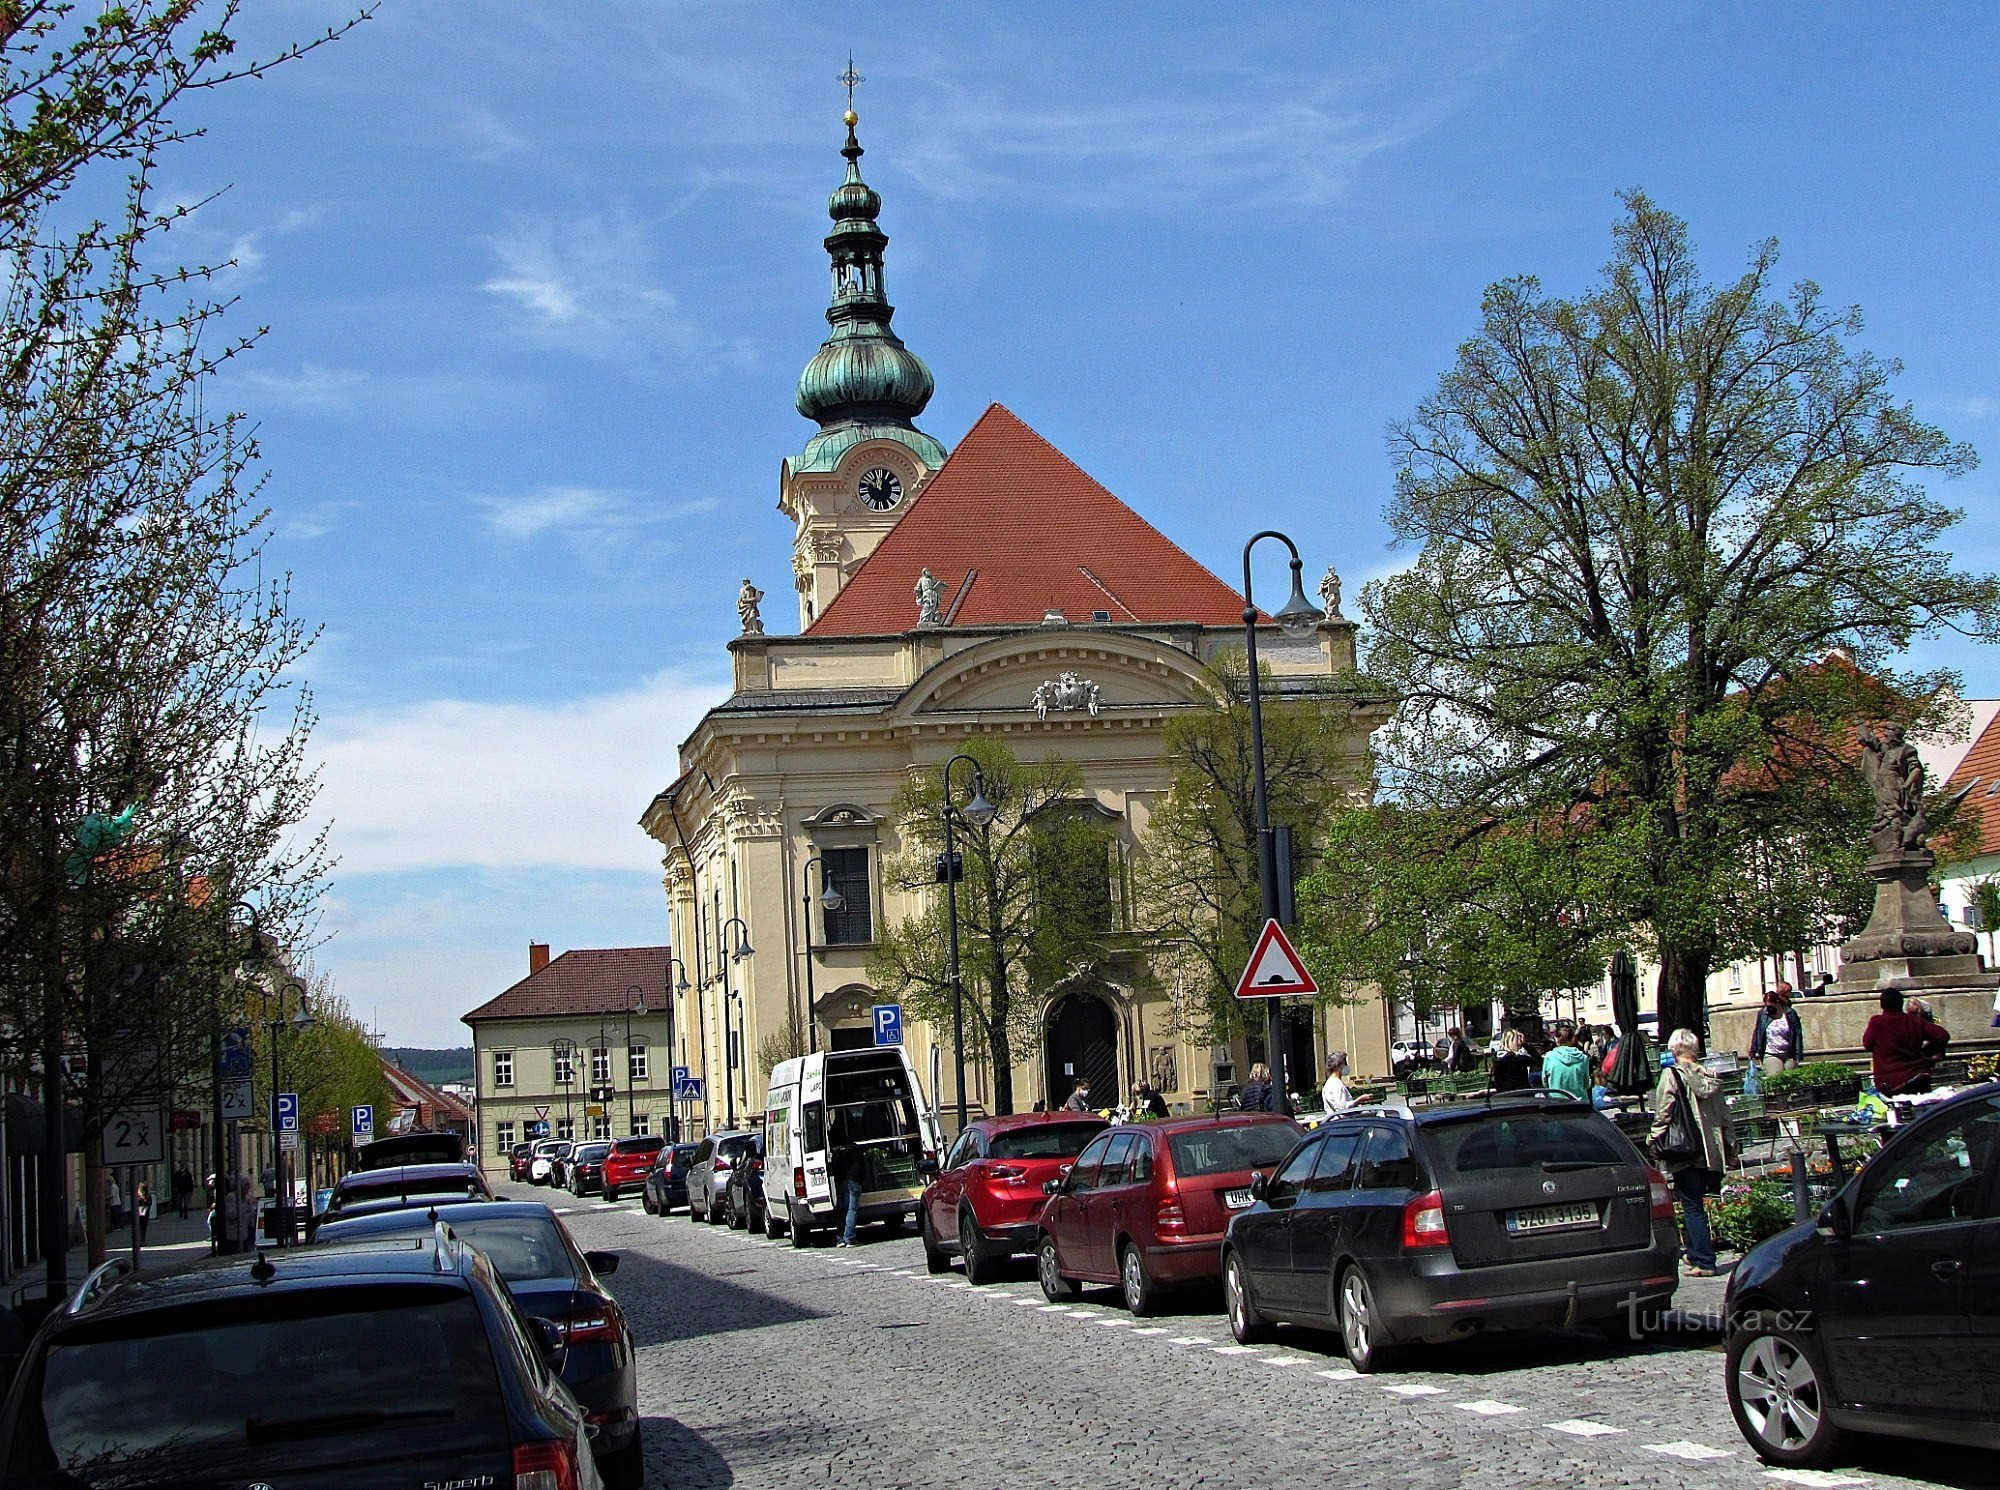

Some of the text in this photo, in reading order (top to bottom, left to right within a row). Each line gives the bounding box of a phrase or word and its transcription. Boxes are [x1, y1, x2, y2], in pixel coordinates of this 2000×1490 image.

[879, 1010, 895, 1032] P
[675, 1069, 685, 1083] P
[278, 1097, 292, 1121] P
[356, 1108, 368, 1125] P
[424, 1475, 494, 1490] Superb
